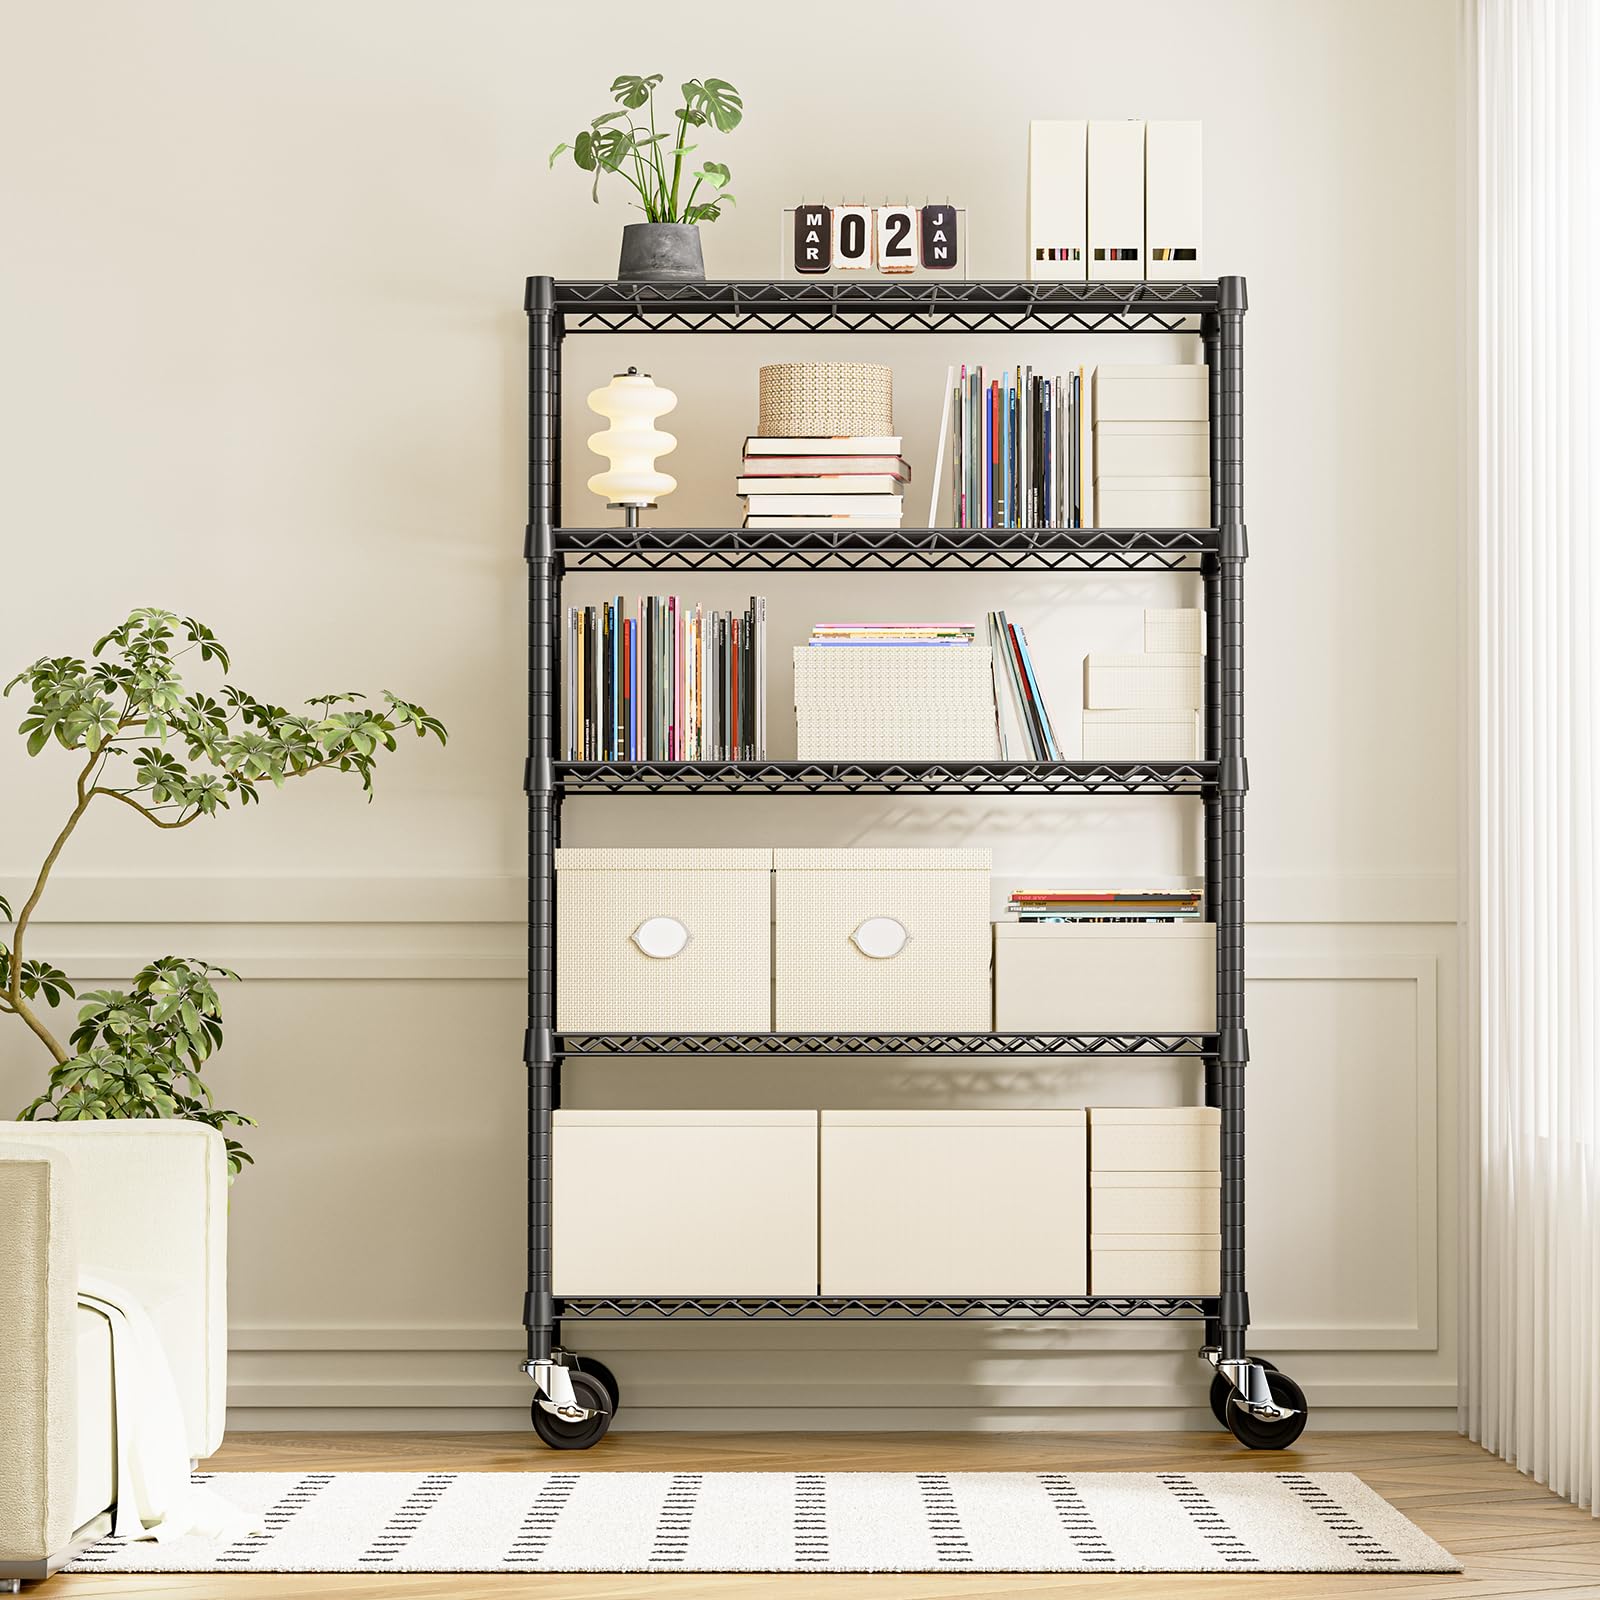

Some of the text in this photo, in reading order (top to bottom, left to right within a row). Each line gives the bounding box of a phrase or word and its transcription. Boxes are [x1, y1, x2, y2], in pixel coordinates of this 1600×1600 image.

[805, 213, 948, 260] MAR 0 2 JAN
